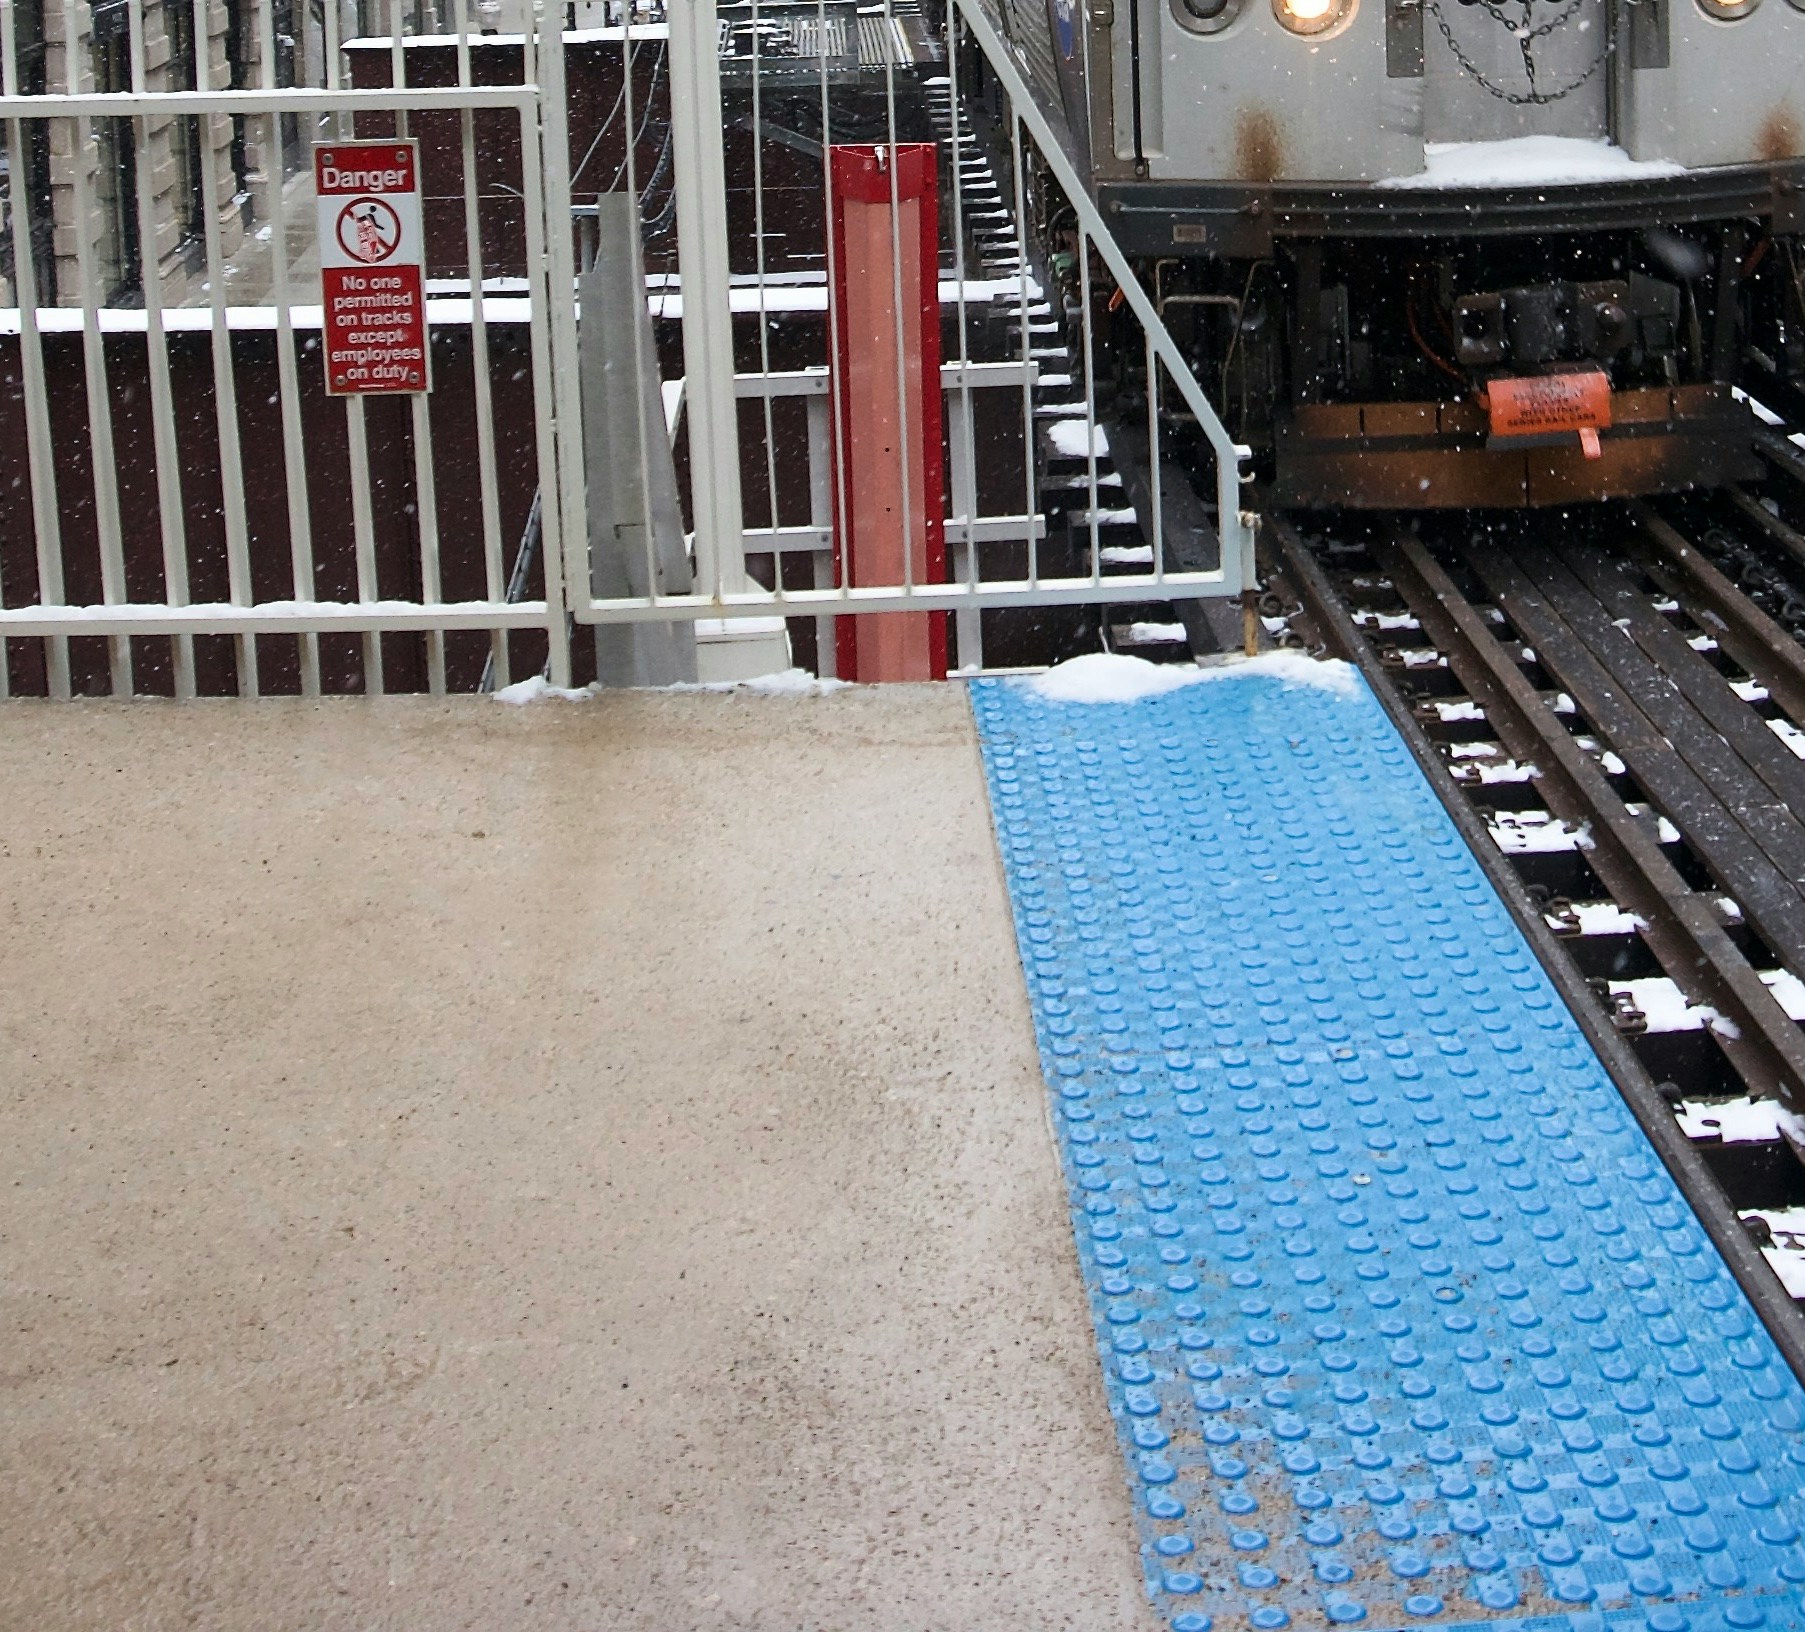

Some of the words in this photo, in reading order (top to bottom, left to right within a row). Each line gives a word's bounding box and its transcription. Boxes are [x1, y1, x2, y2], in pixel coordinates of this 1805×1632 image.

[322, 167, 407, 192] Danger
[342, 275, 367, 290] No
[370, 276, 402, 289] one
[333, 291, 413, 312] permitted
[336, 314, 358, 326] on
[361, 310, 412, 325] tracks
[347, 328, 404, 346] except
[331, 347, 421, 365] employees
[346, 368, 368, 379] on
[372, 364, 409, 381] duty
